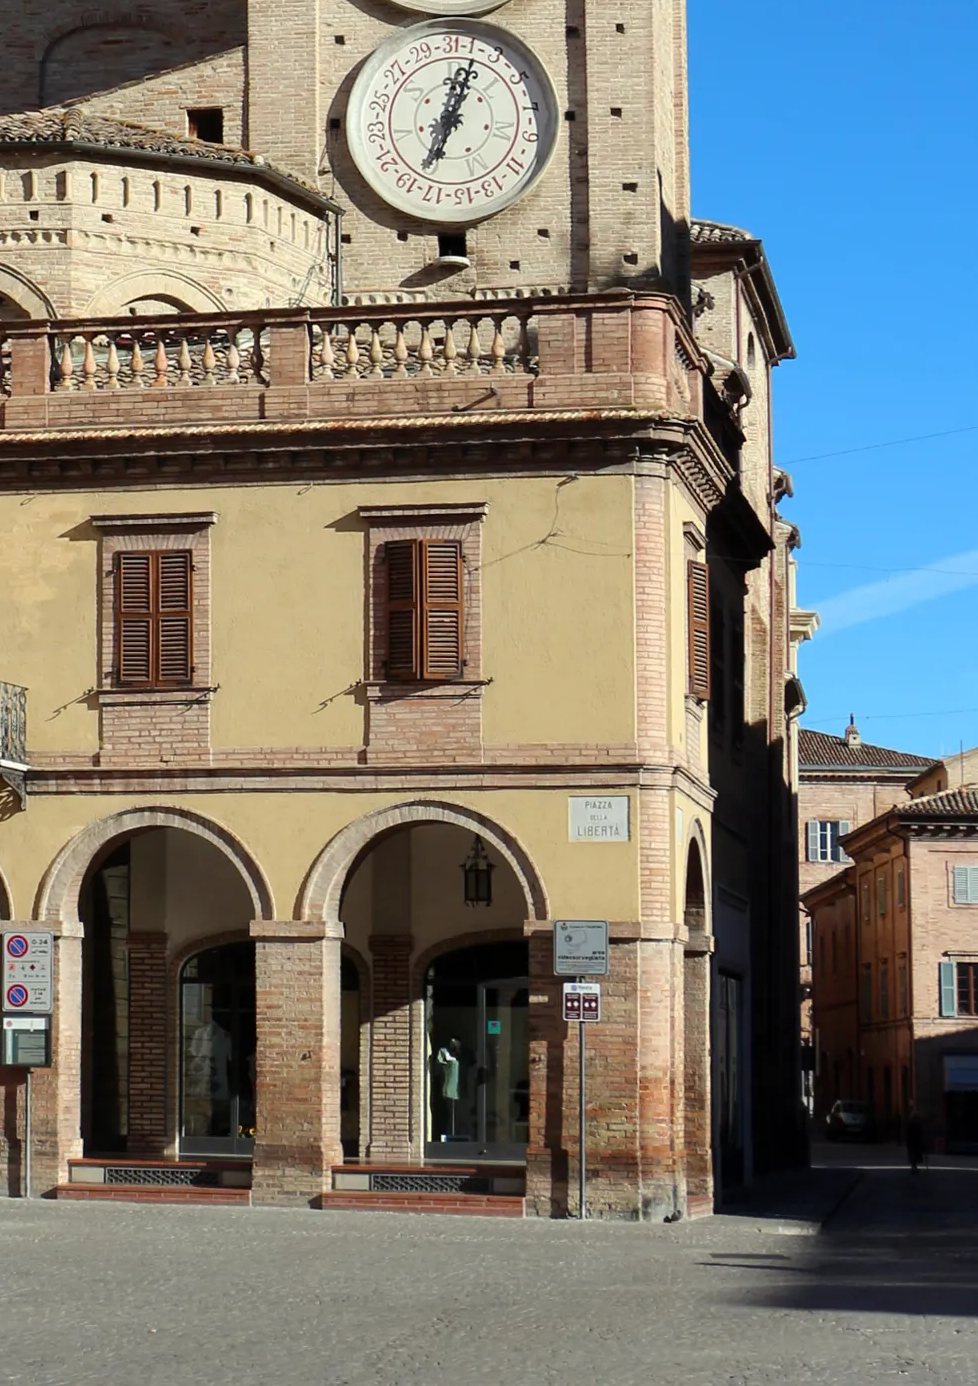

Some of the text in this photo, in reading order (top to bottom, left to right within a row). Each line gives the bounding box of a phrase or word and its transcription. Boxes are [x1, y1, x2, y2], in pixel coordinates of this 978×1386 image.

[410, 42, 432, 64] 29
[442, 35, 459, 54] 31
[468, 37, 477, 54] 1
[488, 46, 504, 63] 3
[384, 60, 407, 84] 27
[510, 70, 530, 85] 5
[403, 79, 425, 103] S
[369, 90, 391, 113] 25
[522, 101, 539, 113] 7
[368, 120, 386, 144] 23
[393, 128, 414, 143] V
[492, 120, 515, 142] M
[522, 130, 539, 143] 9
[375, 149, 399, 173] 21
[464, 153, 489, 177] M
[507, 156, 525, 177] 11
[396, 172, 418, 194] 19
[482, 176, 504, 198] 13
[422, 185, 442, 205] 17
[454, 187, 474, 206] 15
[584, 801, 613, 810] PIAZZA
[577, 822, 620, 837] LIBERTÀ
